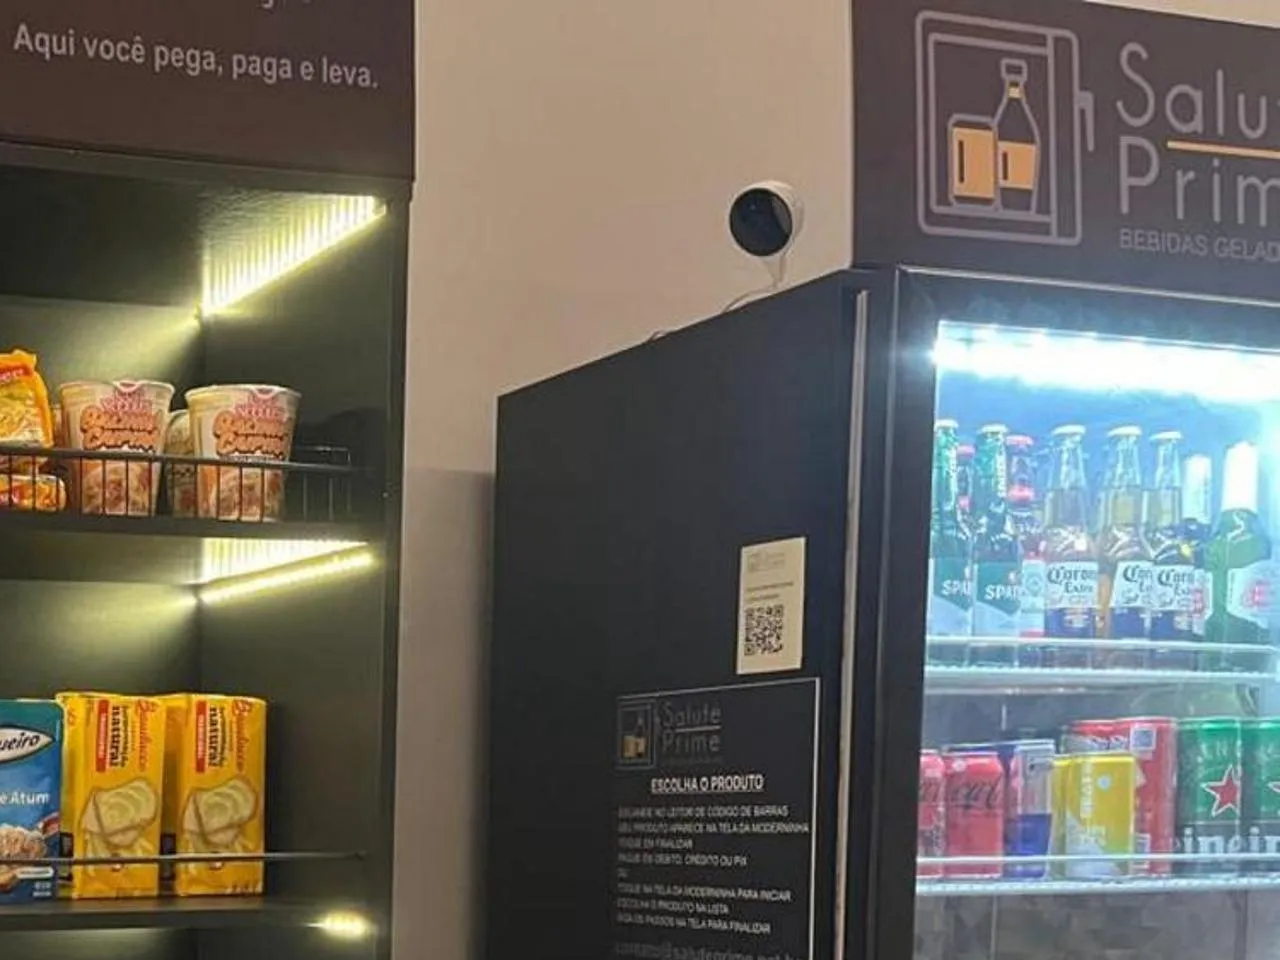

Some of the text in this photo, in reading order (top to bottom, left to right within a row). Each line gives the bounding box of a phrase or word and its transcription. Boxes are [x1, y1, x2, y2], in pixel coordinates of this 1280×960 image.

[14, 23, 379, 89] Aqui você pega, paga e leva.
[1117, 42, 1280, 138] Salu
[1120, 228, 1208, 257] BEBIDAS
[663, 701, 721, 728] Salute
[109, 706, 122, 768] natural
[207, 707, 219, 768] natural
[664, 729, 720, 752] Prime
[9, 790, 50, 805] Atum
[651, 774, 765, 793] ESCOLHA O PRODUTO
